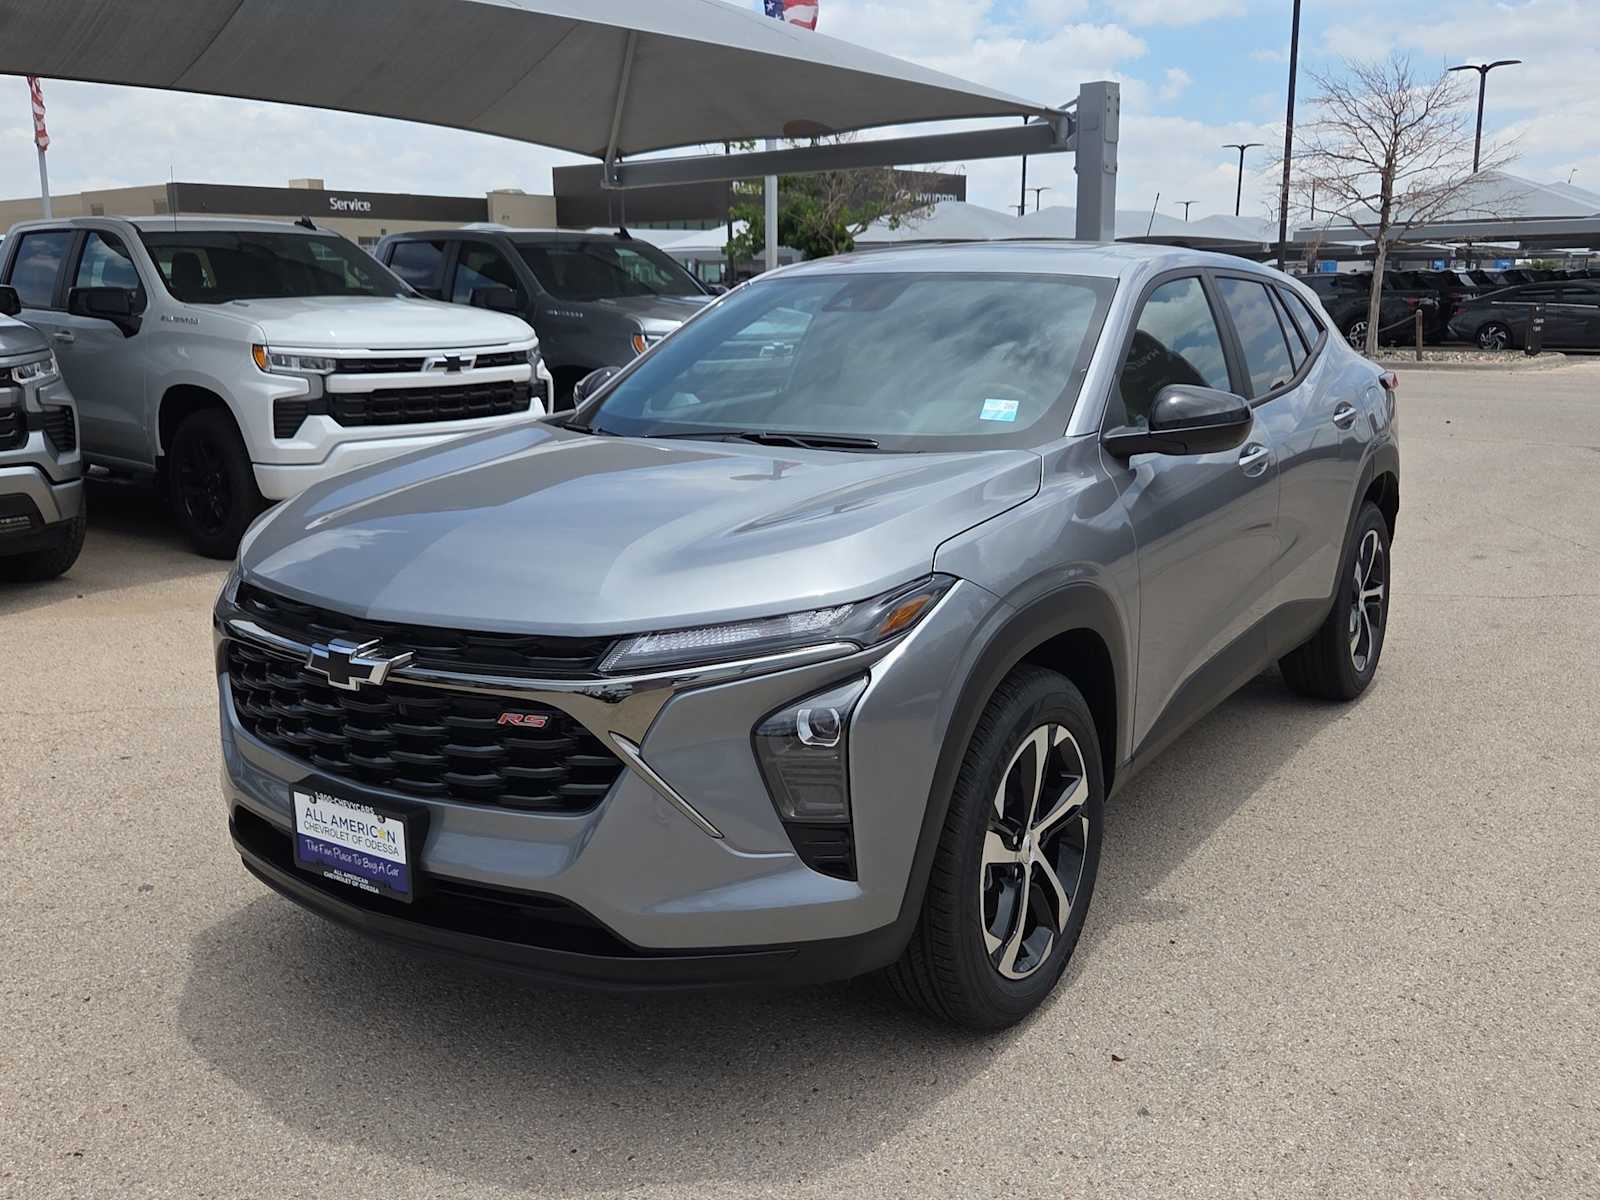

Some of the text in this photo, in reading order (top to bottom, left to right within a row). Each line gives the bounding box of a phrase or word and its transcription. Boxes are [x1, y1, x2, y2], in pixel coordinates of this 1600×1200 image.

[329, 197, 371, 211] Service
[497, 713, 548, 728] RS
[305, 807, 327, 824] ALL
[304, 821, 399, 857] CHEVROLET OF ODESSA
[305, 839, 399, 877] The Fun Place To Buy A Car
